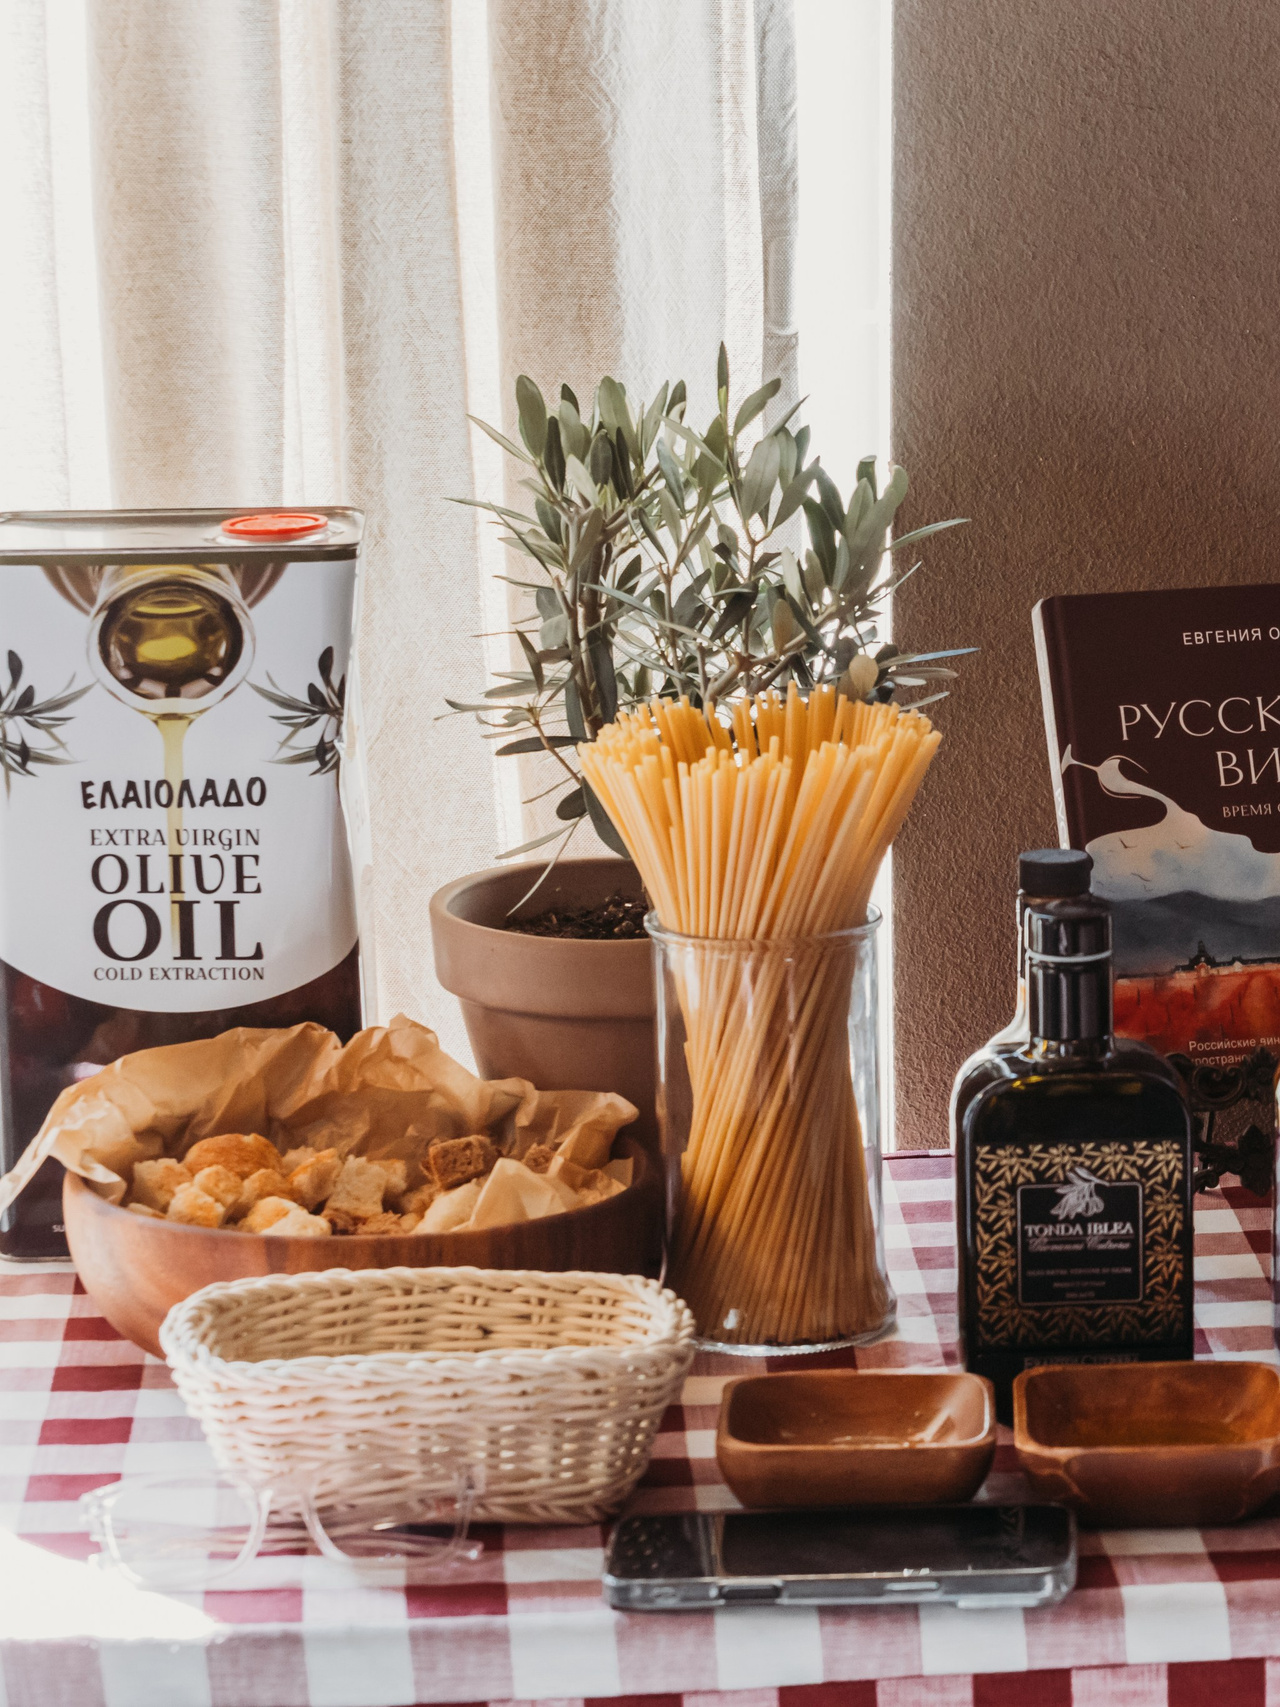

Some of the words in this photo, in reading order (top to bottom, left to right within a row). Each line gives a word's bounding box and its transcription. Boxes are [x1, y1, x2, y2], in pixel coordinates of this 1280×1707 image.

[1182, 628, 1262, 646] ЕВГЕНИЯ
[1222, 803, 1273, 818] ВРЕМЯ
[90, 828, 168, 847] EXTRA
[174, 828, 261, 851] VIRGIN
[91, 853, 263, 895] OLIVE
[93, 898, 265, 963] OIL
[93, 967, 143, 981] COLD
[150, 966, 265, 981] EXTRACTION
[1188, 1037, 1257, 1052] Российские
[1023, 1223, 1084, 1238] TONDA
[1086, 1221, 1135, 1235] IBLEA
